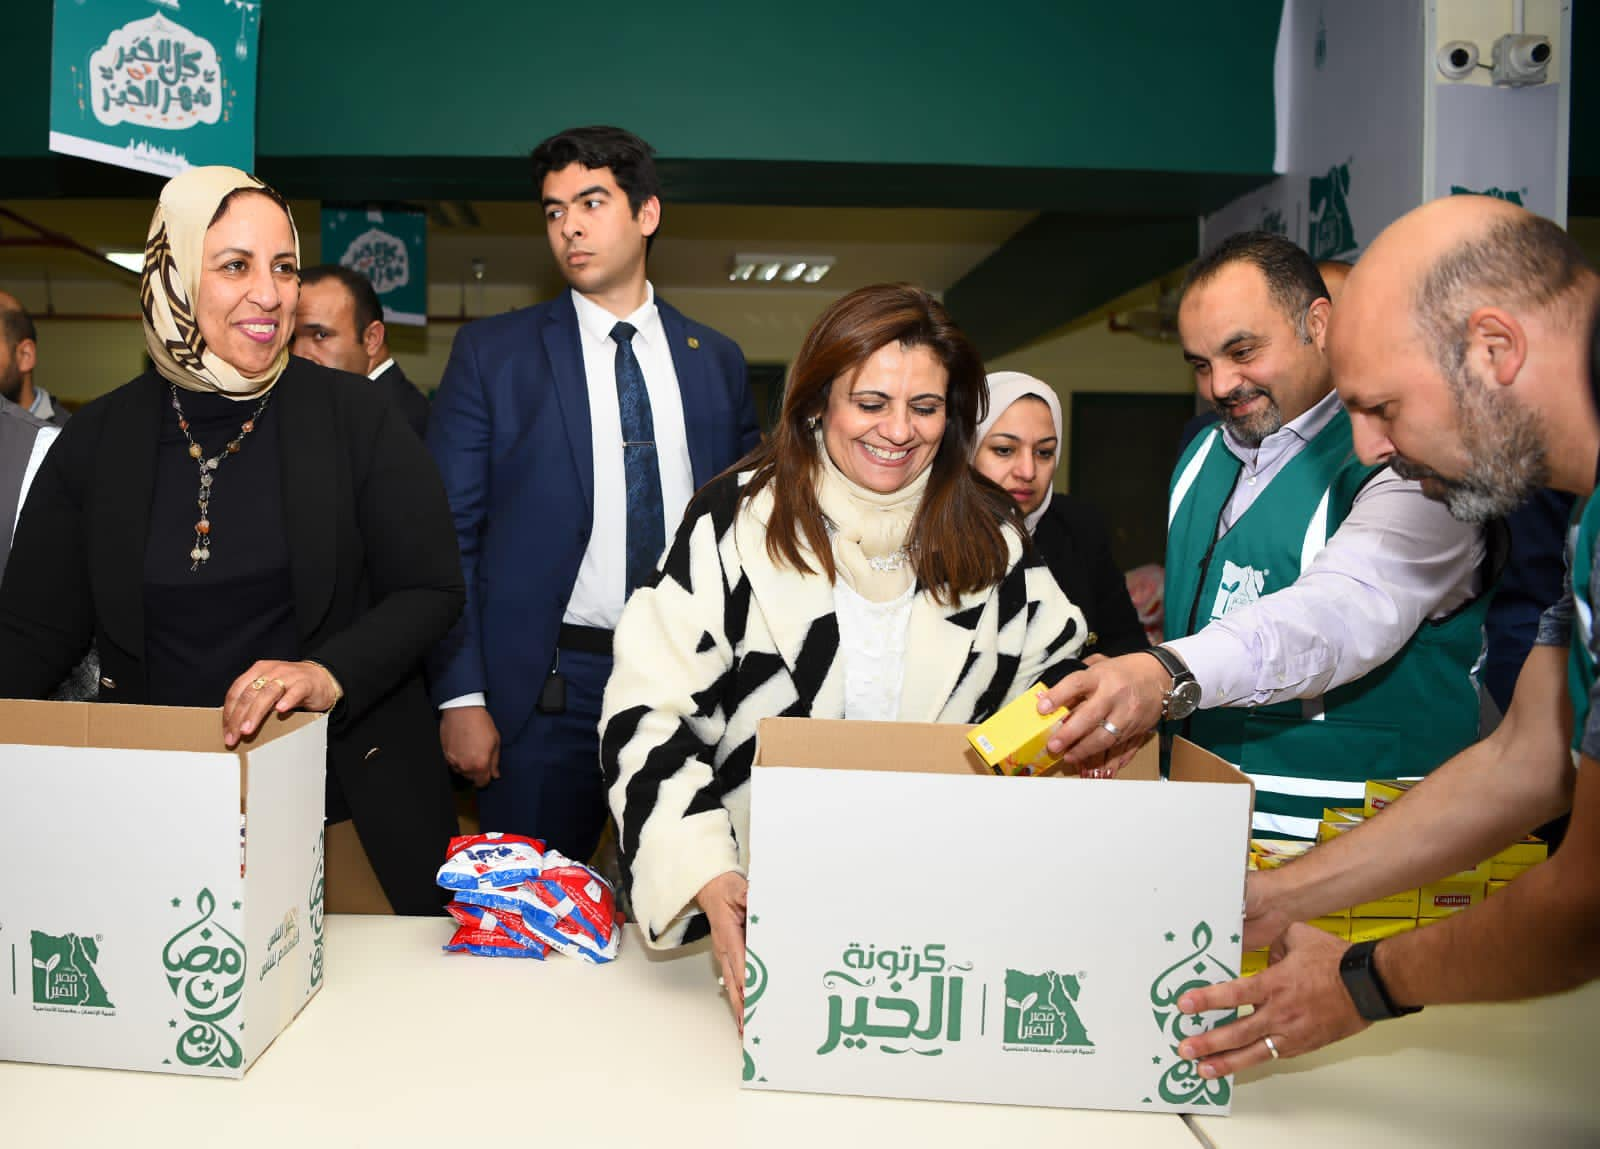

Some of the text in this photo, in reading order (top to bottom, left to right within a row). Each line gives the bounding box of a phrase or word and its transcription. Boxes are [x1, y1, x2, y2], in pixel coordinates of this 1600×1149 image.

[161, 85, 212, 115] شهر
[842, 942, 946, 982] كرتونة
[55, 973, 78, 985] مصر
[50, 982, 78, 1000] الخير
[816, 975, 964, 1056] الخير
[1029, 1012, 1055, 1024] مصر
[1022, 1022, 1055, 1039] الخير
